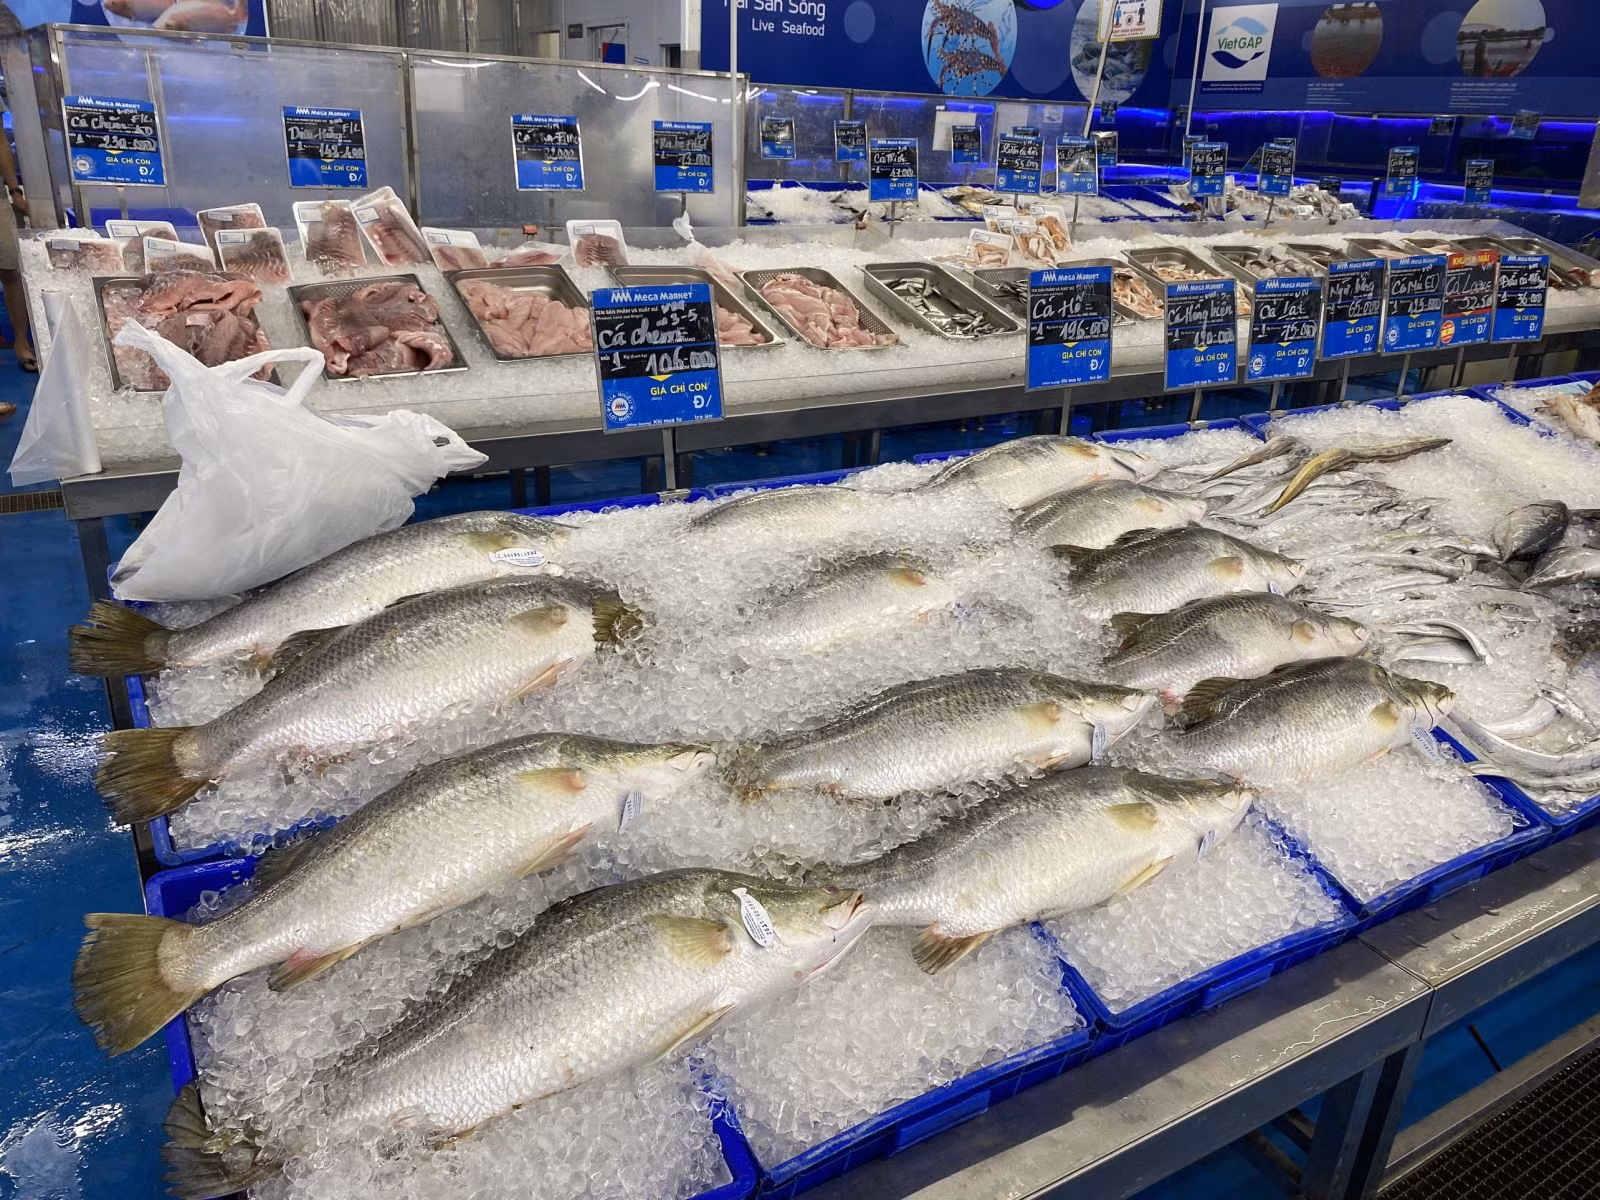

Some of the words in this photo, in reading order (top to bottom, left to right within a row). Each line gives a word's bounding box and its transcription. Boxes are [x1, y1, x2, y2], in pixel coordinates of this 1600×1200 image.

[752, 18, 775, 32] Live
[782, 21, 825, 36] Seafood
[1218, 36, 1263, 50] VietGAP
[634, 293, 658, 302] Mega
[659, 291, 693, 300] Market
[1032, 296, 1055, 320] Cá
[598, 322, 627, 349] Cá
[610, 351, 626, 372] 1
[1061, 350, 1074, 359] GIÁ
[1089, 359, 1105, 371] Đ/
[650, 384, 667, 396] GIÁ
[670, 381, 686, 394] CHỈ
[693, 394, 713, 409] Đ/
